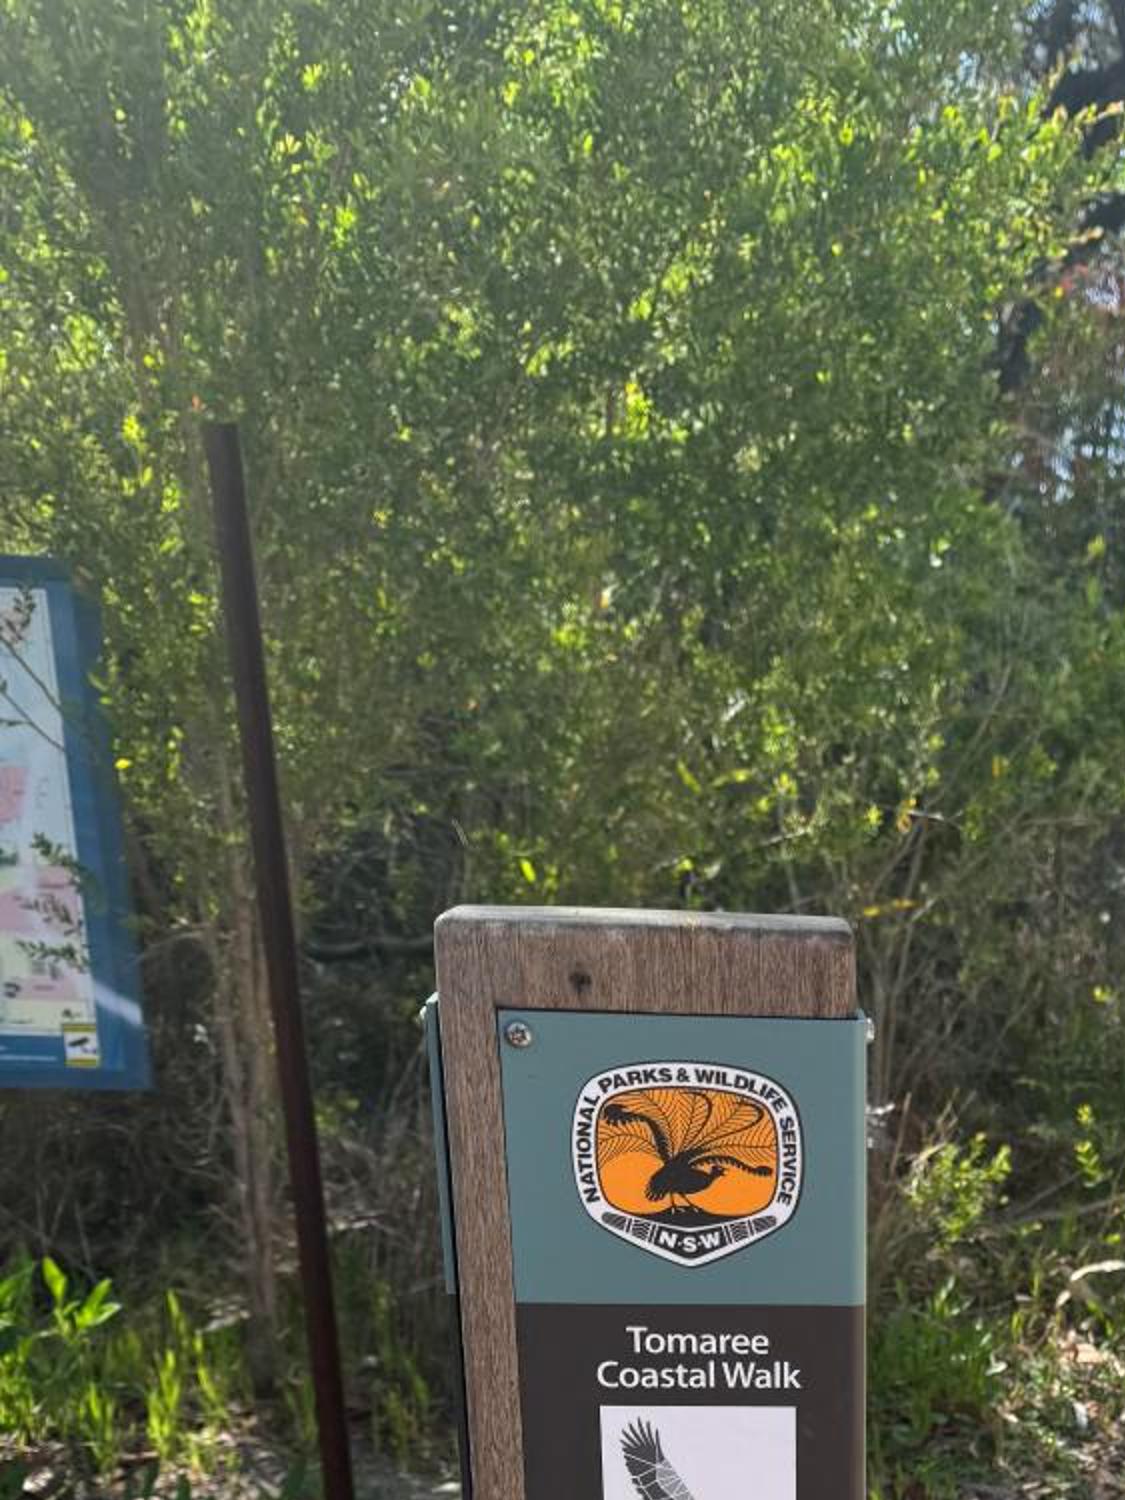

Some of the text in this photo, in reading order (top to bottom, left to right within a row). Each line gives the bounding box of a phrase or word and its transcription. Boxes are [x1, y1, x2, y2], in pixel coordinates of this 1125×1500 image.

[575, 1067, 797, 1207] NATIONAL PARKS & WILDLIFE SERVICE
[625, 1326, 769, 1355] Tomaree
[597, 1360, 801, 1389] Coastal Walk
